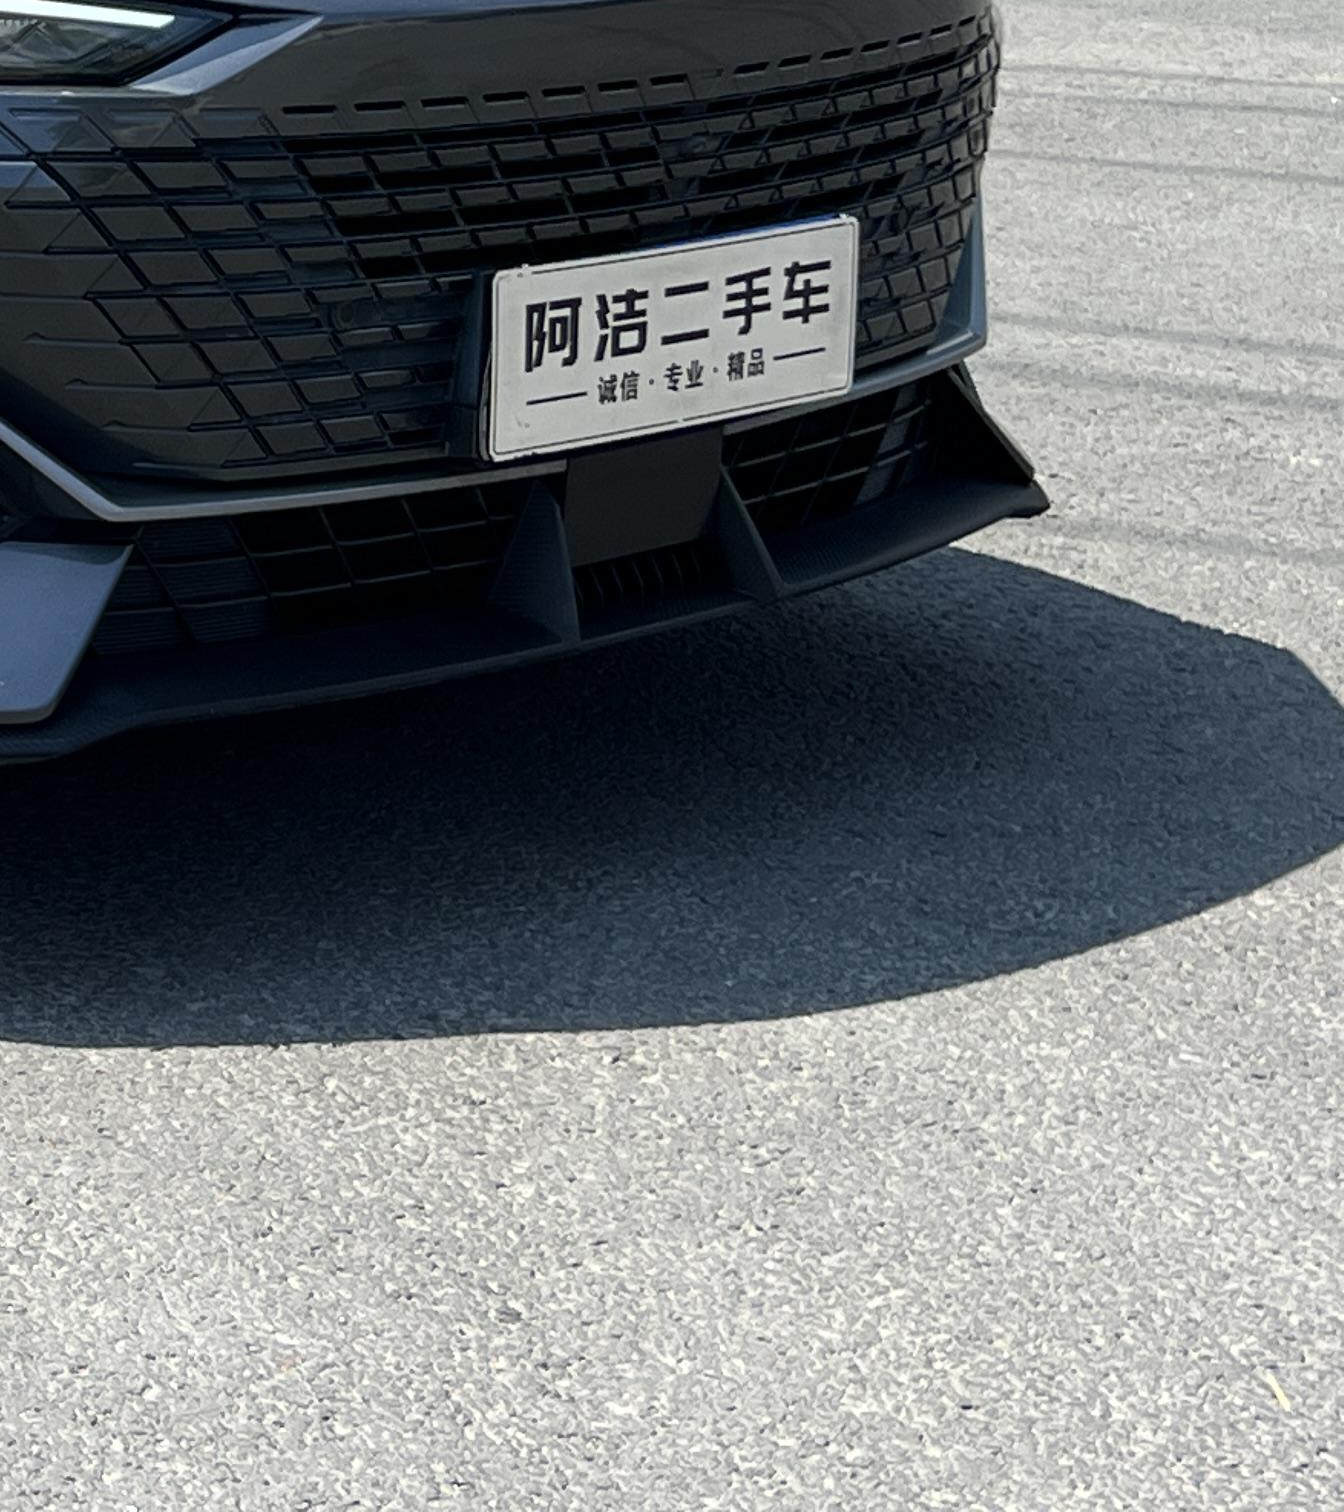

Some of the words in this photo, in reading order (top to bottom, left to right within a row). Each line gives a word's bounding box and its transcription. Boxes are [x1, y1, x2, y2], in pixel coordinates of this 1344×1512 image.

[525, 260, 832, 373] 阿洁二手车
